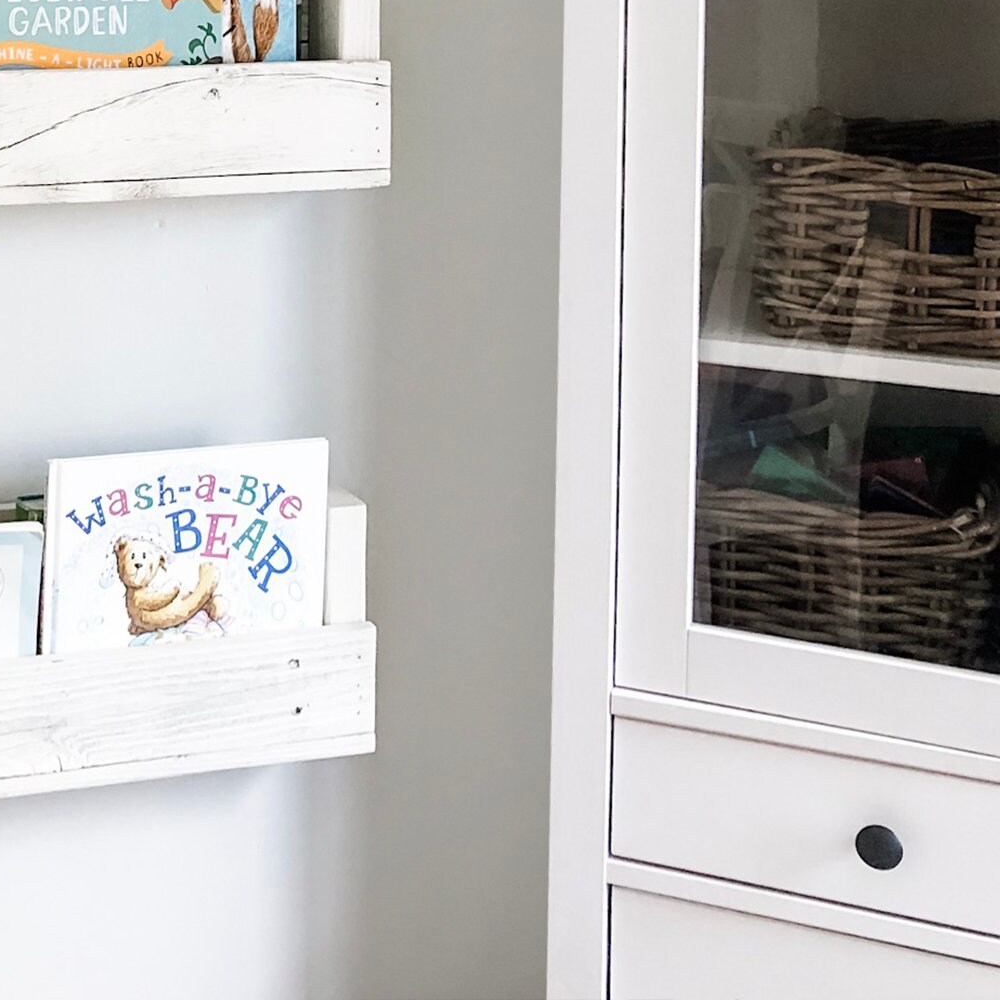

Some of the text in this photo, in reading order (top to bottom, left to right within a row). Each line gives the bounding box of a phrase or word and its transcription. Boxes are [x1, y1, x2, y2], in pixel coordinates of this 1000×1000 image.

[7, 5, 129, 37] GARDEN
[127, 51, 164, 68] BOOK
[165, 508, 293, 593] BEAR
